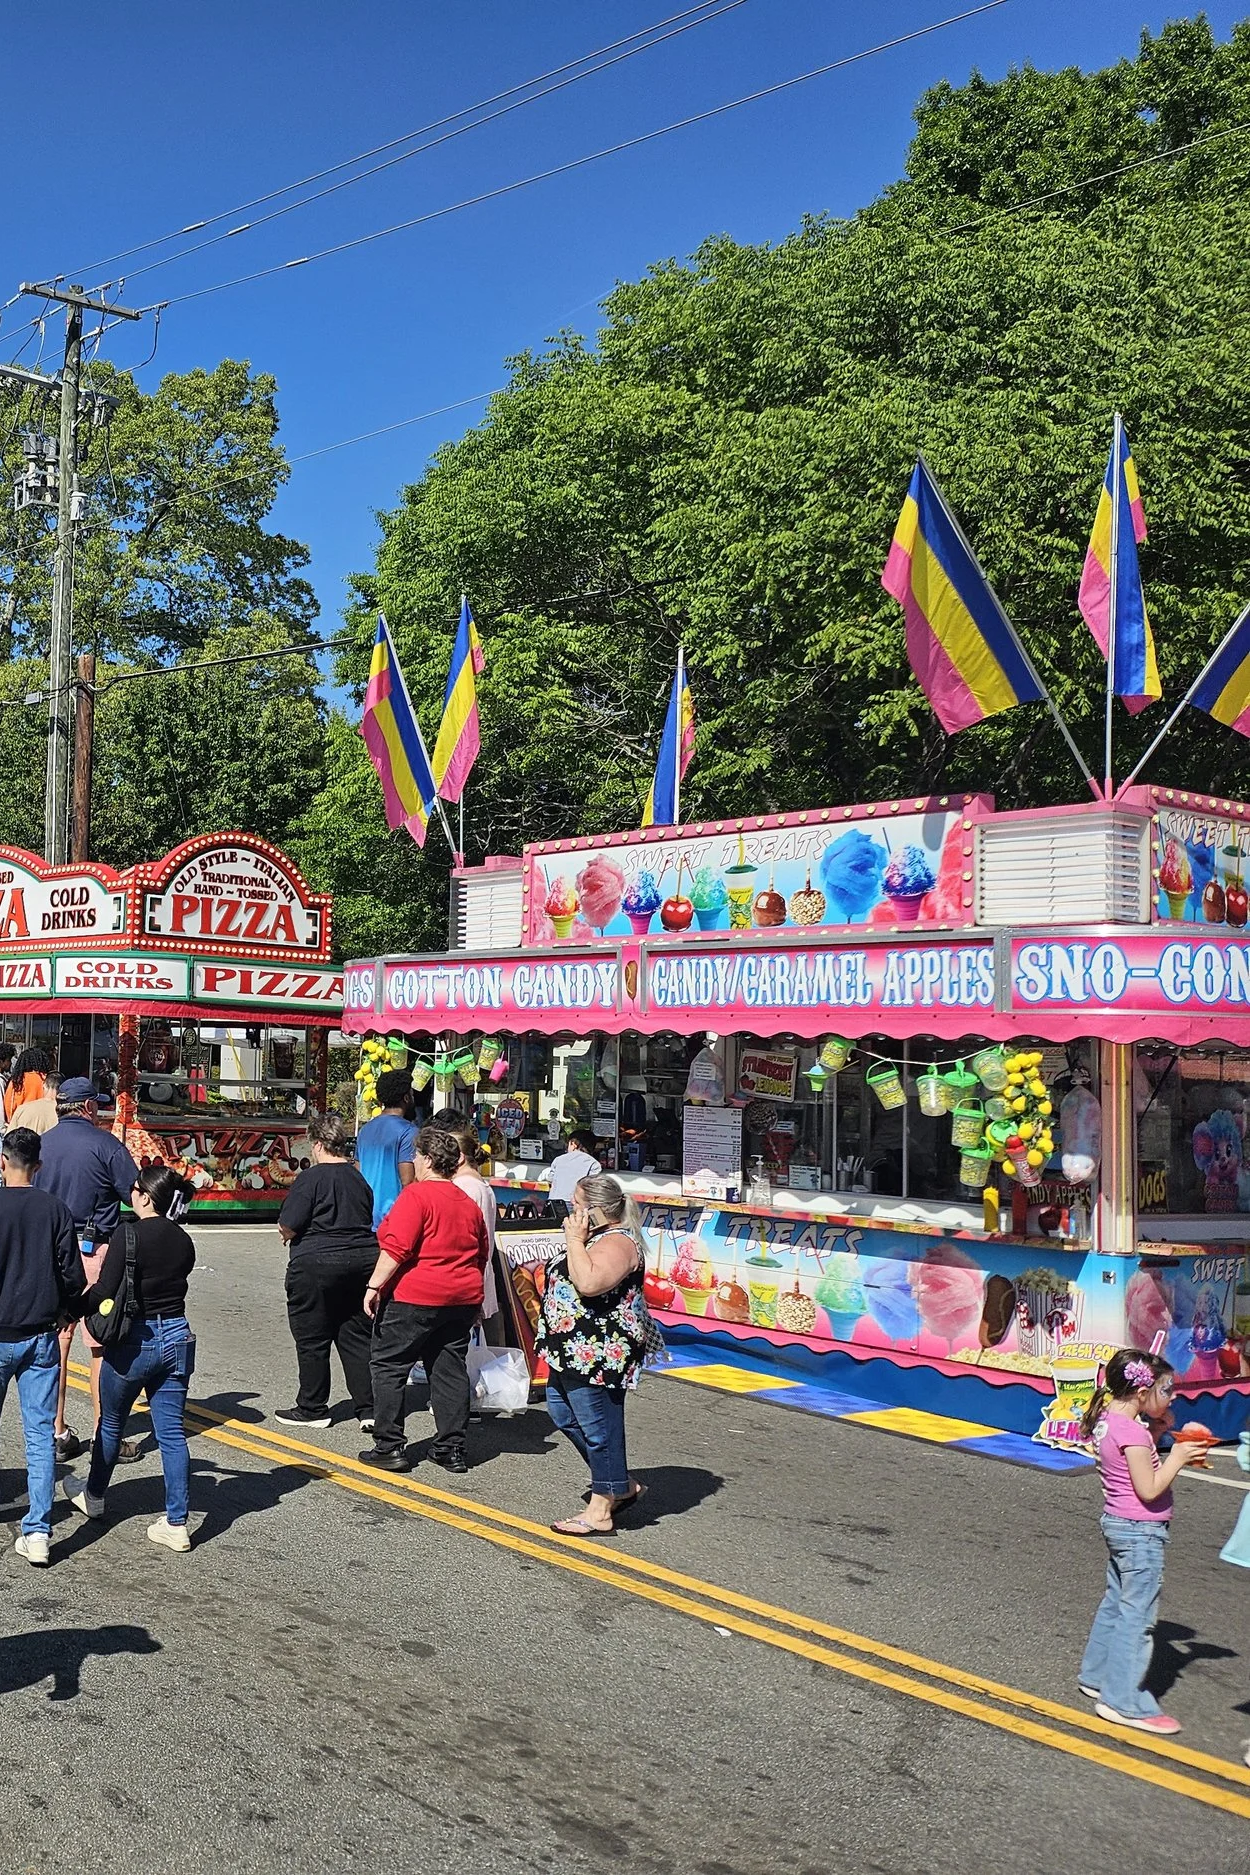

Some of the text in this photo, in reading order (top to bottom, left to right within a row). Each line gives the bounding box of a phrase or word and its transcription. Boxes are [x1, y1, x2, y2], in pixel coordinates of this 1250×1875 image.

[1164, 812, 1230, 848] SWEET
[623, 829, 832, 877] SWEET TREATS
[174, 851, 297, 904] OLD STYLE ITALIAN
[201, 872, 271, 888] TRADITIONAL
[49, 887, 90, 907] COLD
[193, 884, 278, 901] HAND TOSSED
[41, 908, 96, 931] DRINKS
[169, 894, 300, 943] PIZZA
[77, 962, 159, 975] COLD
[653, 948, 995, 1007] CANDY/CARAMEL APPLES
[65, 976, 174, 990] DRINKS
[201, 966, 345, 1000] PIZZA
[389, 963, 618, 1008] COTTON CANDY
[498, 1108, 523, 1119] ICED
[498, 1118, 521, 1131] TEA
[163, 1131, 292, 1160] PIZZA
[1139, 1170, 1166, 1209] DOGS
[725, 1216, 863, 1259] TREATS
[507, 1244, 540, 1266] CORN
[1191, 1257, 1246, 1284] SWEET
[1058, 1343, 1093, 1359] FRESH
